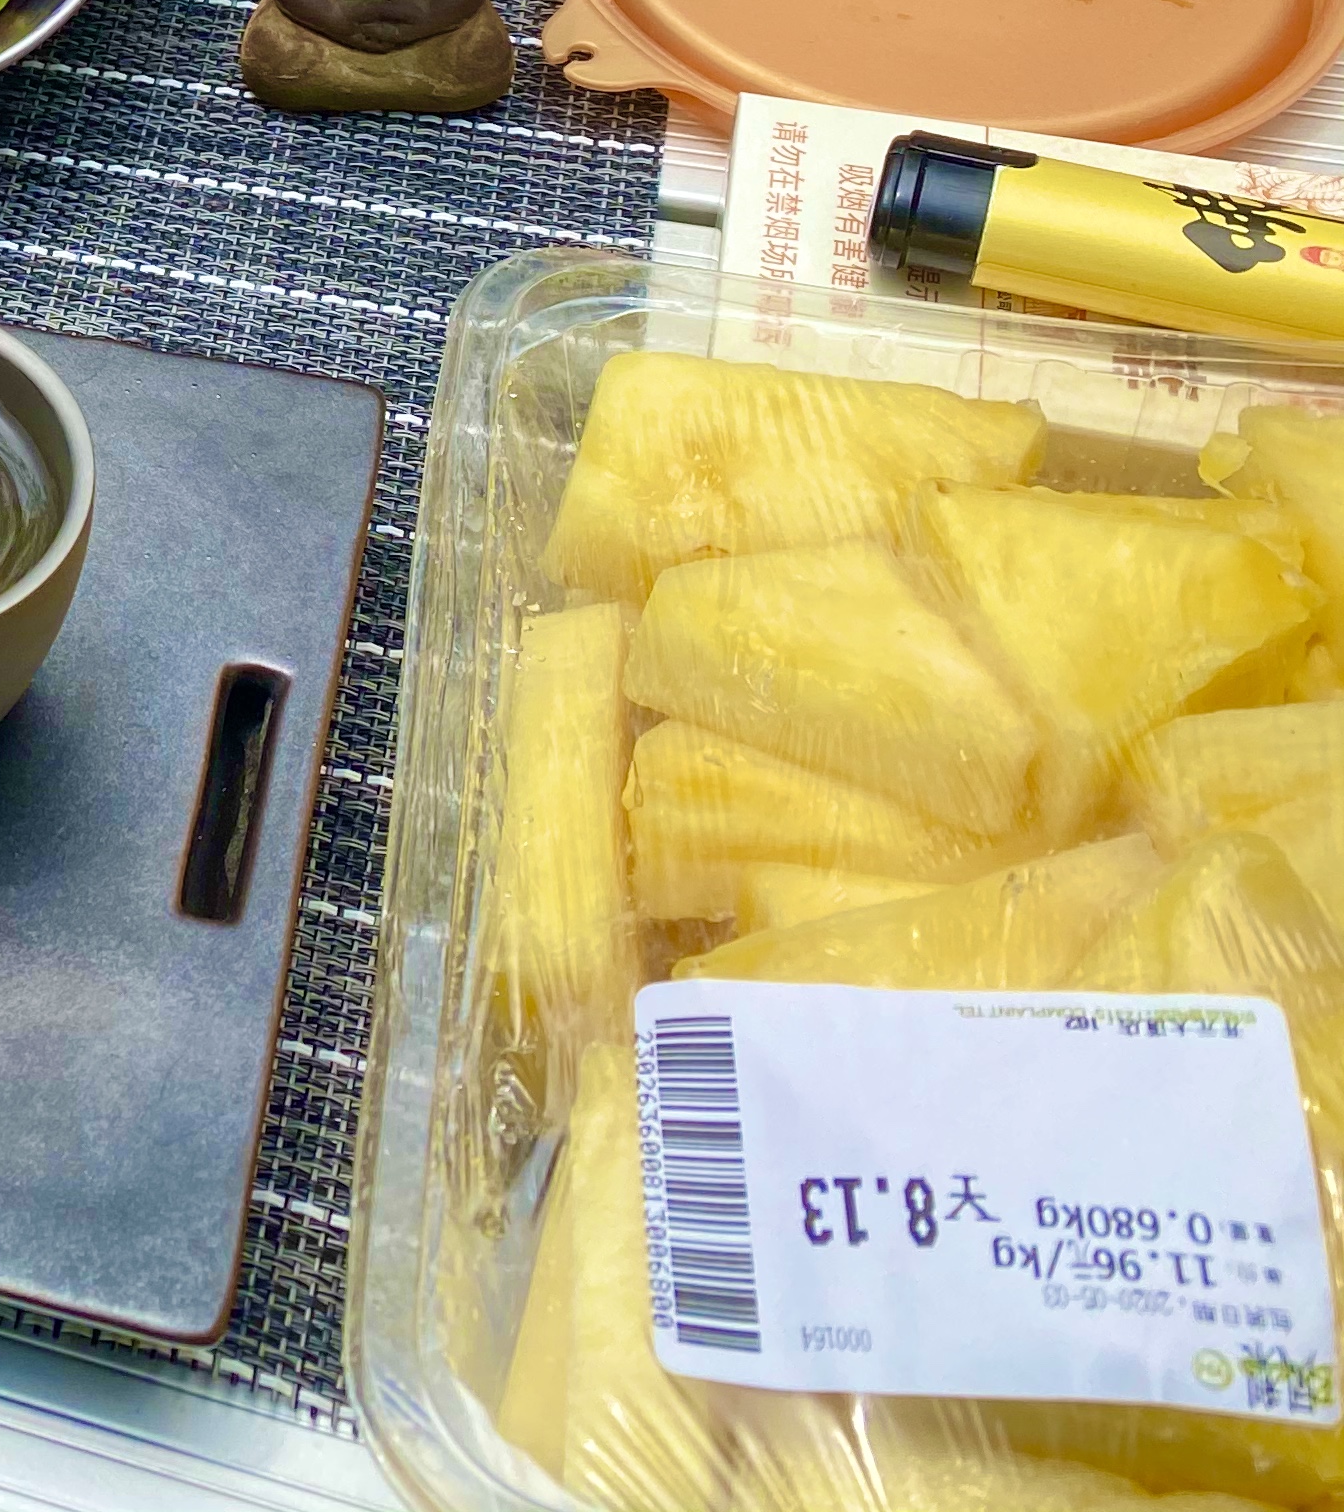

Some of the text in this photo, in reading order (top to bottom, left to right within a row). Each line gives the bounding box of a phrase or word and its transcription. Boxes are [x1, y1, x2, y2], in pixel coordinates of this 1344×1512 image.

[753, 121, 809, 348] 请勿在禁烟场所
[829, 163, 874, 318] 吸烟有害健
[1036, 1196, 1214, 1244] 0.680kg
[992, 1234, 1215, 1288] 11.96元/kg
[800, 1324, 873, 1353] 000164
